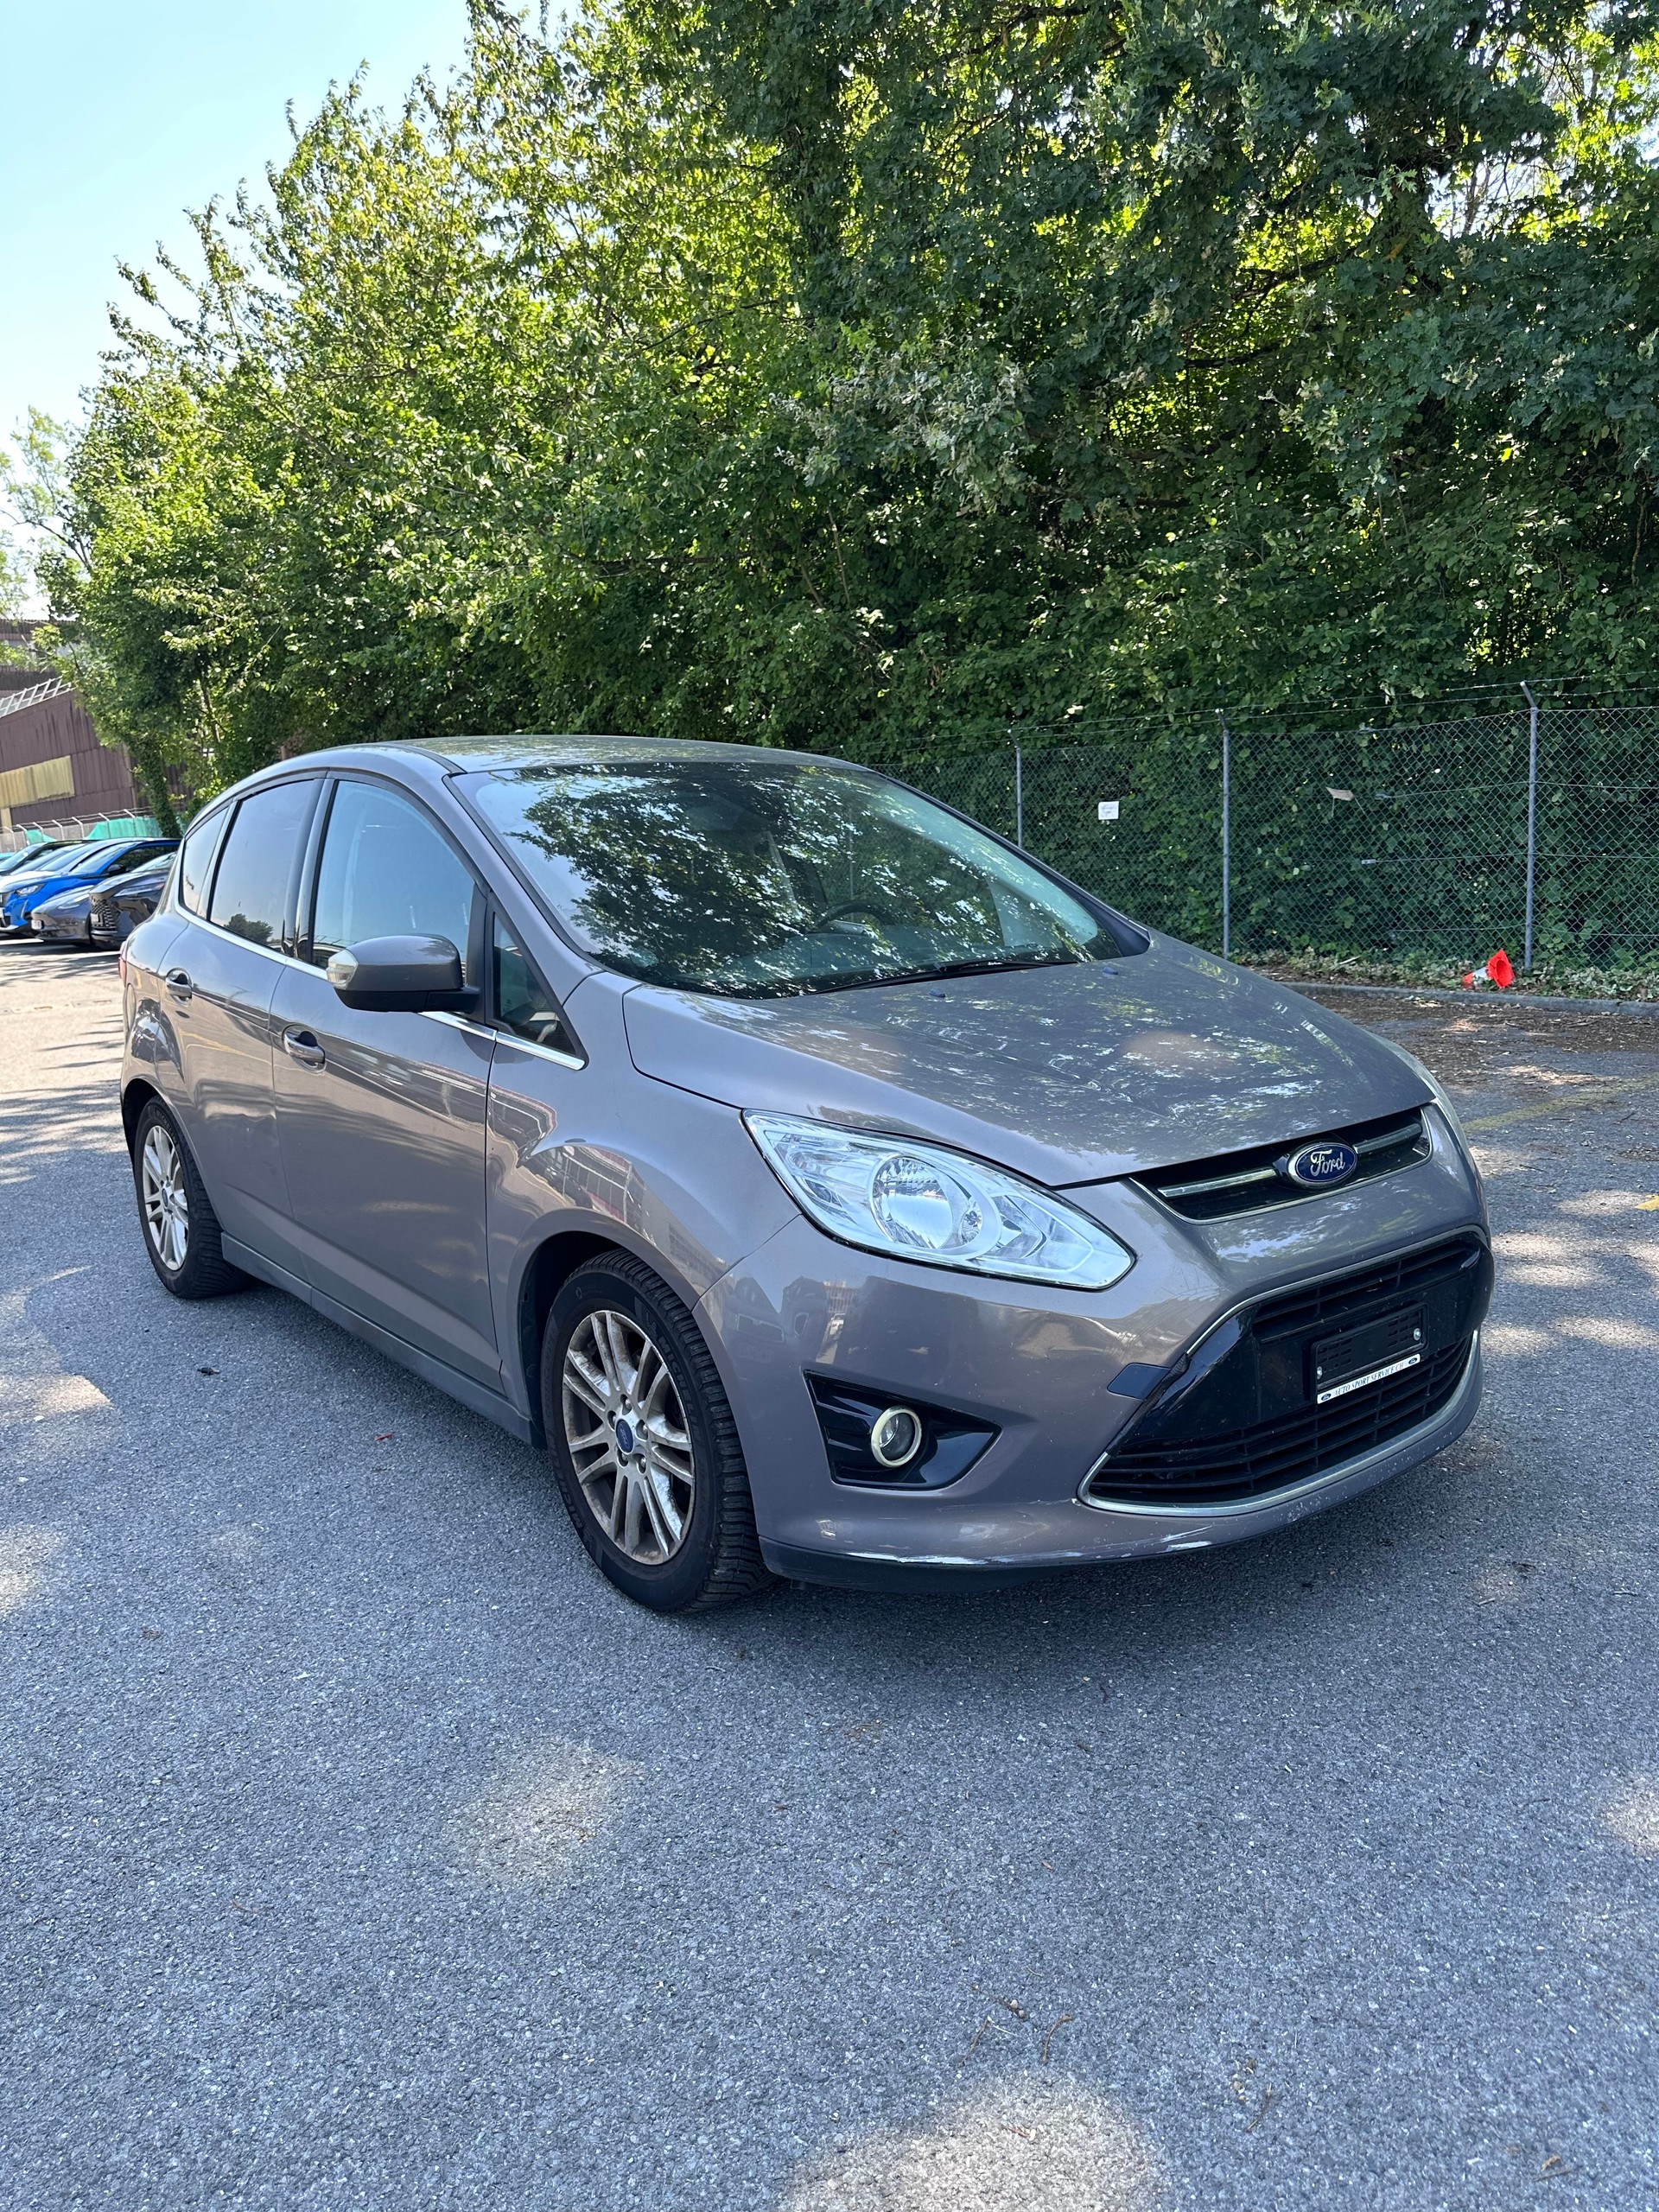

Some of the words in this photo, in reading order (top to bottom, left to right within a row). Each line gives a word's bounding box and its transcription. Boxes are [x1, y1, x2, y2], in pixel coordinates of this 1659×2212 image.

[1310, 1148, 1345, 1177] Ford
[658, 1336, 702, 1441] MICHELIN
[1351, 1376, 1370, 1390] SPORT
